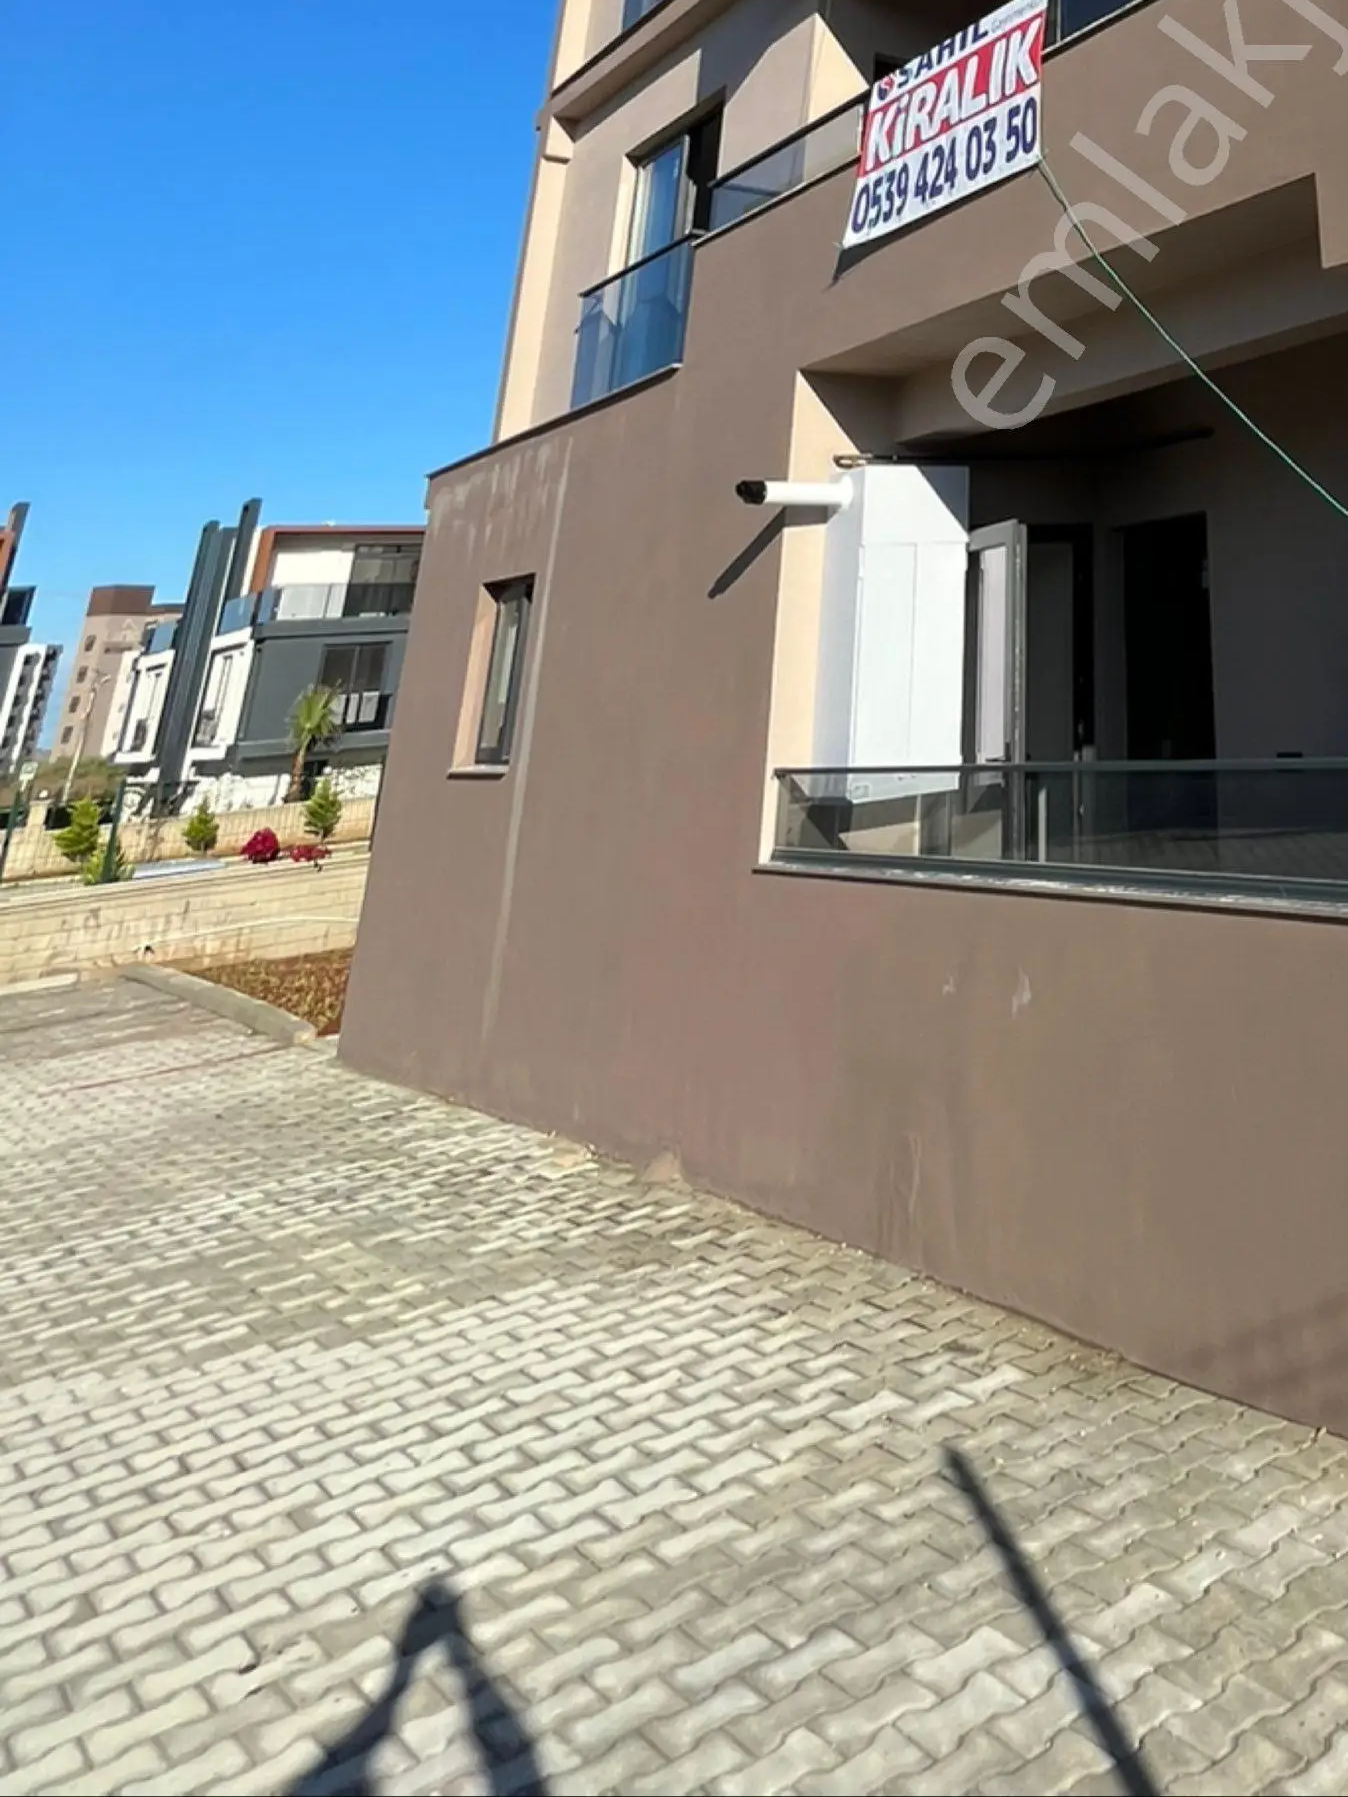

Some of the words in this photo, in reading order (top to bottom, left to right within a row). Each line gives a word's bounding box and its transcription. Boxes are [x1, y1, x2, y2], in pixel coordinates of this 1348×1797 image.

[851, 162, 910, 234] 0539
[914, 136, 958, 204] 424
[965, 117, 997, 181] 03
[1005, 96, 1037, 164] 50
[865, 16, 1042, 172] KİRALIK
